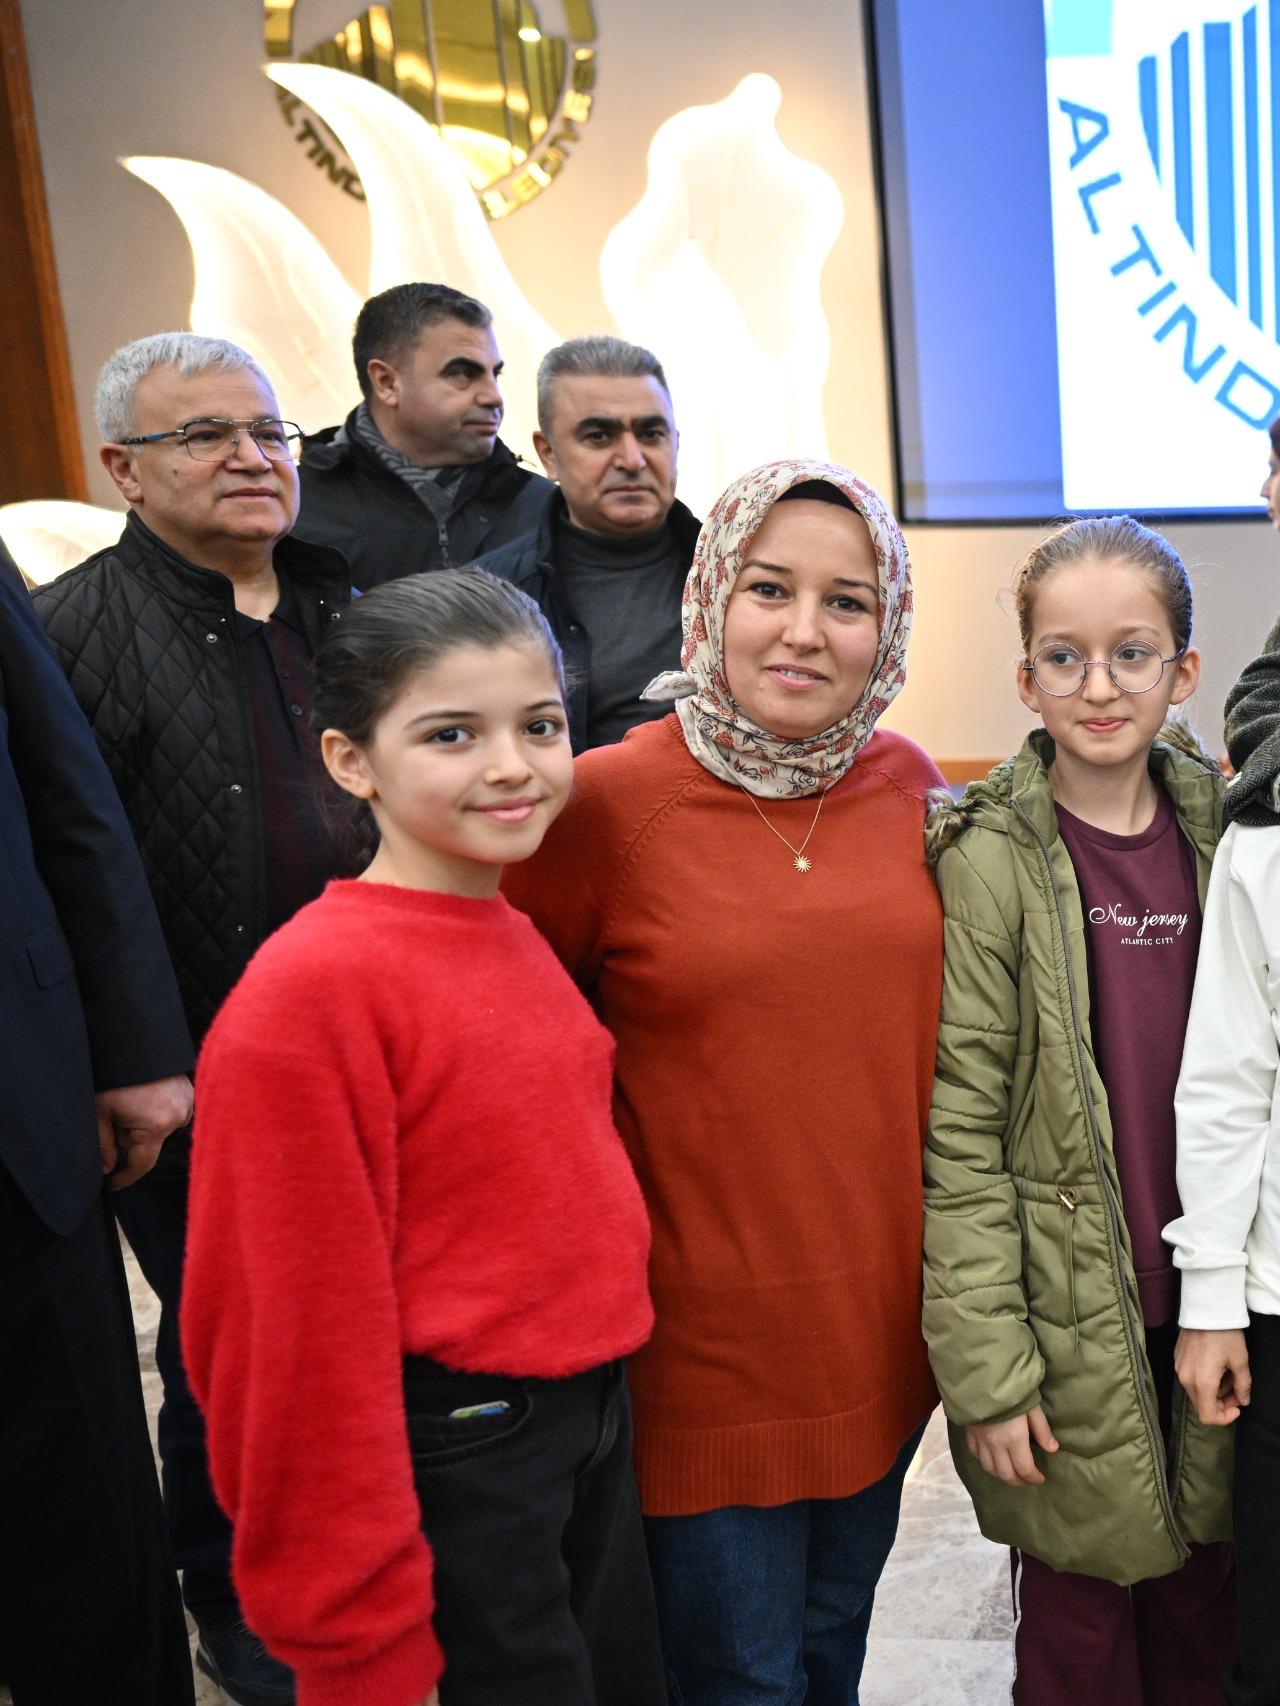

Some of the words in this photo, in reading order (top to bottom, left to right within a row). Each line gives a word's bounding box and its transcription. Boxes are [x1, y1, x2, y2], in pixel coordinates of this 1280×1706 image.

[1089, 903, 1137, 926] New
[1137, 909, 1188, 936] jersey
[1120, 937, 1153, 946] ATLANTIC
